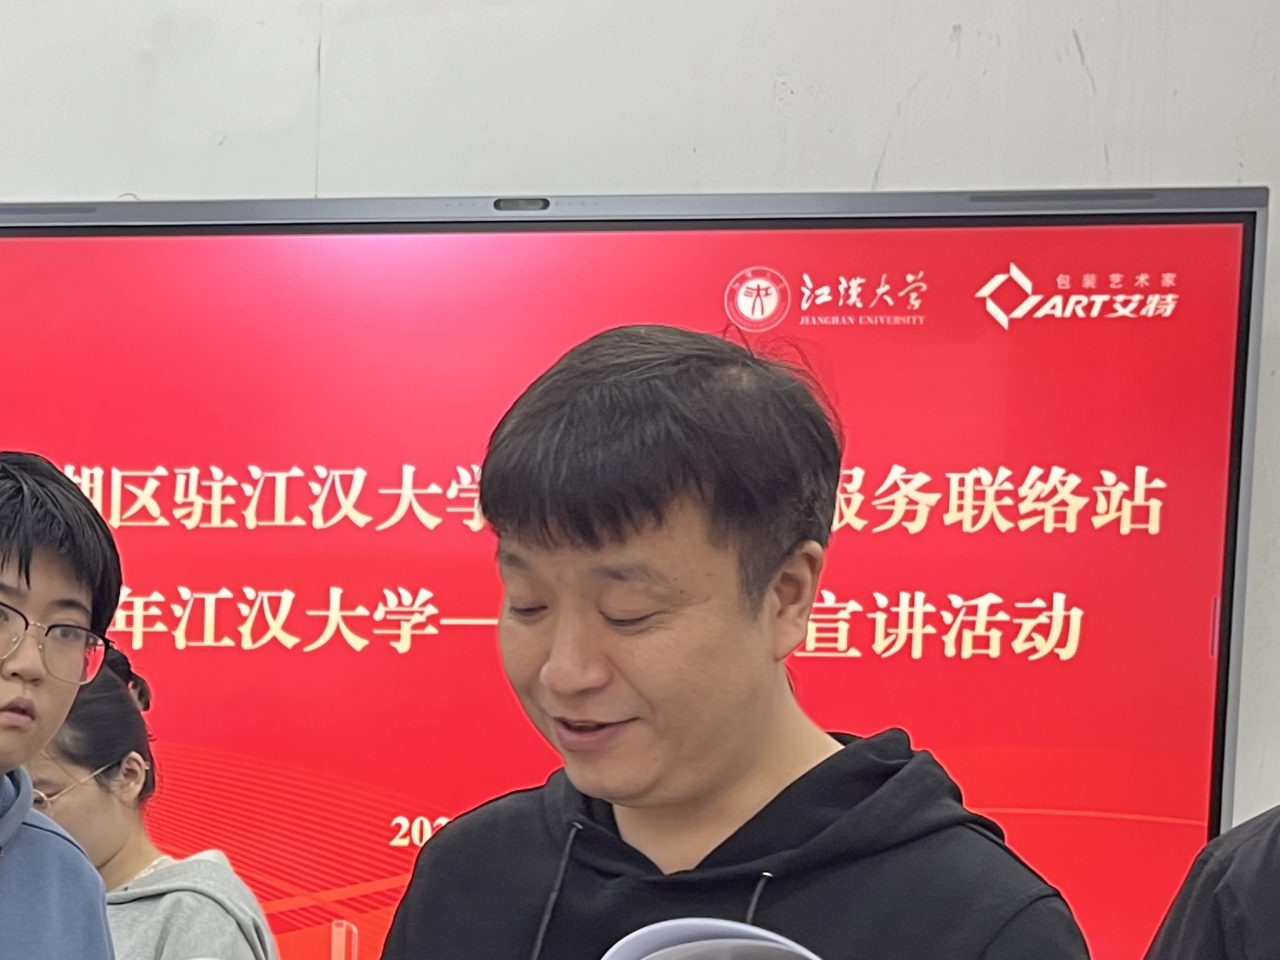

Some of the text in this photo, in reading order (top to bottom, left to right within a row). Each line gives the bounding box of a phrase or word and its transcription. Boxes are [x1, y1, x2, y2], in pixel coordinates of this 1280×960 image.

[1055, 272, 1177, 290] 包装艺术家
[800, 315, 926, 326] JIANGHAN UNIVERSITY
[793, 589, 1085, 661] 宣讲活动
